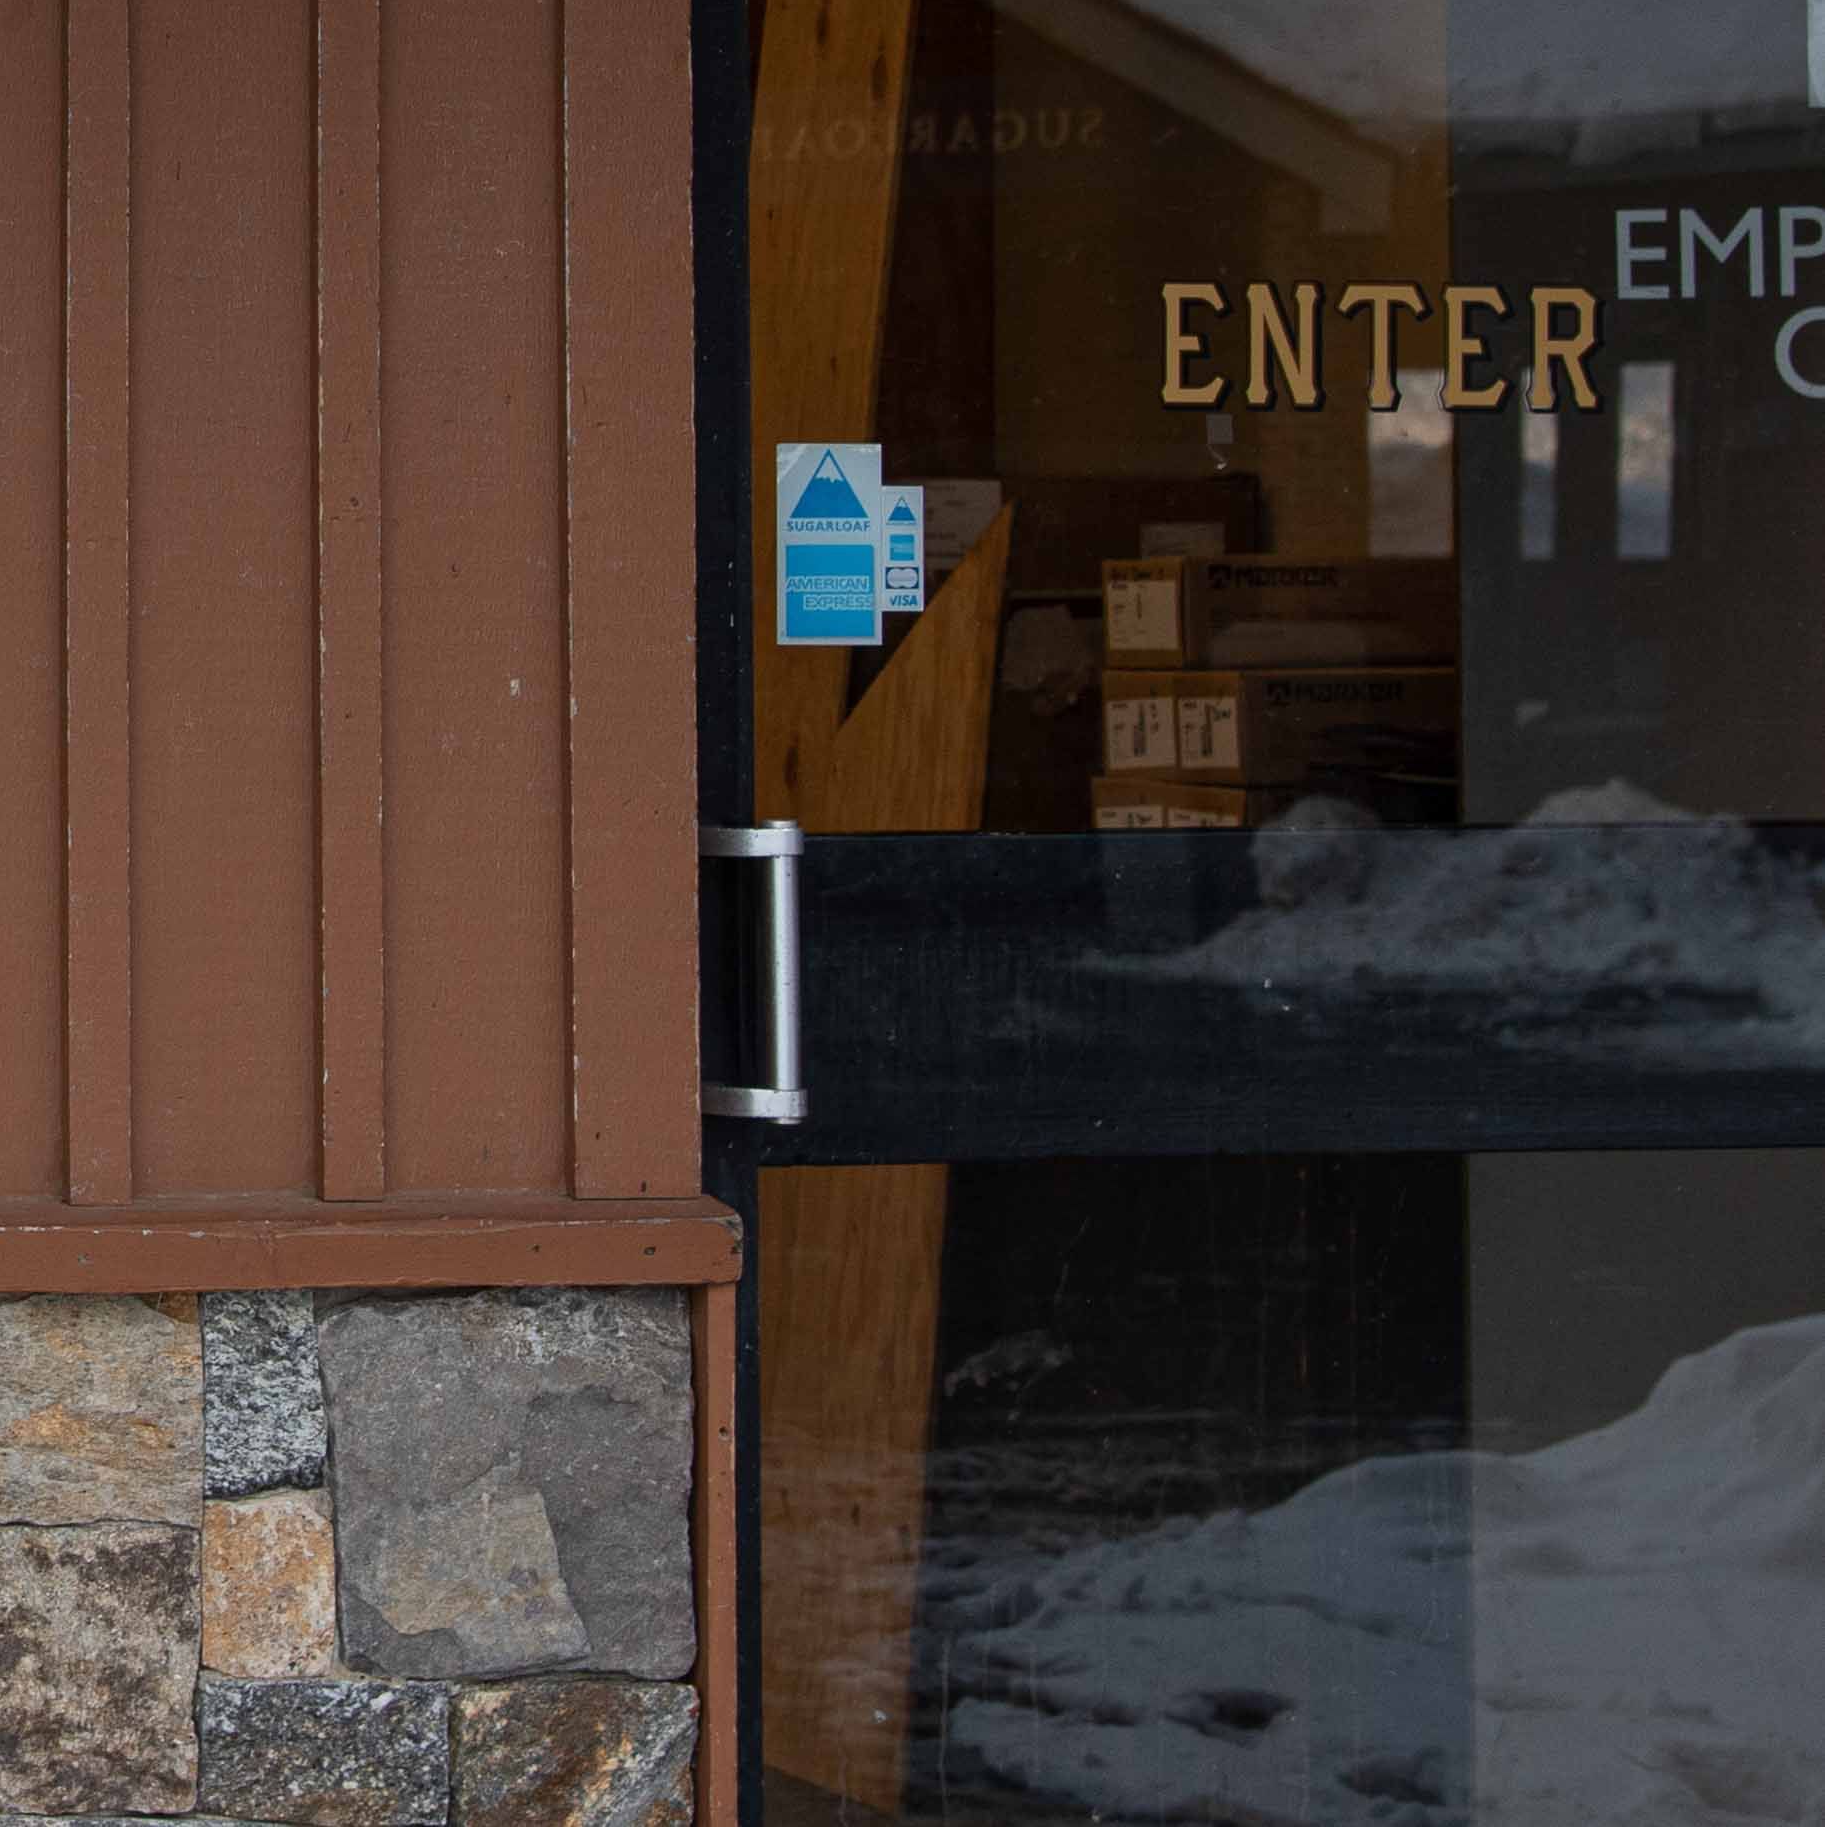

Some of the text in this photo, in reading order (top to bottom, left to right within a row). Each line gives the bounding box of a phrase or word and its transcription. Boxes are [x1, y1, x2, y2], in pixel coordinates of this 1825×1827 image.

[1161, 282, 1602, 411] ENTER
[787, 521, 870, 532] SUGARLOAF
[786, 576, 869, 590] AMERICAN
[890, 595, 919, 606] VISA
